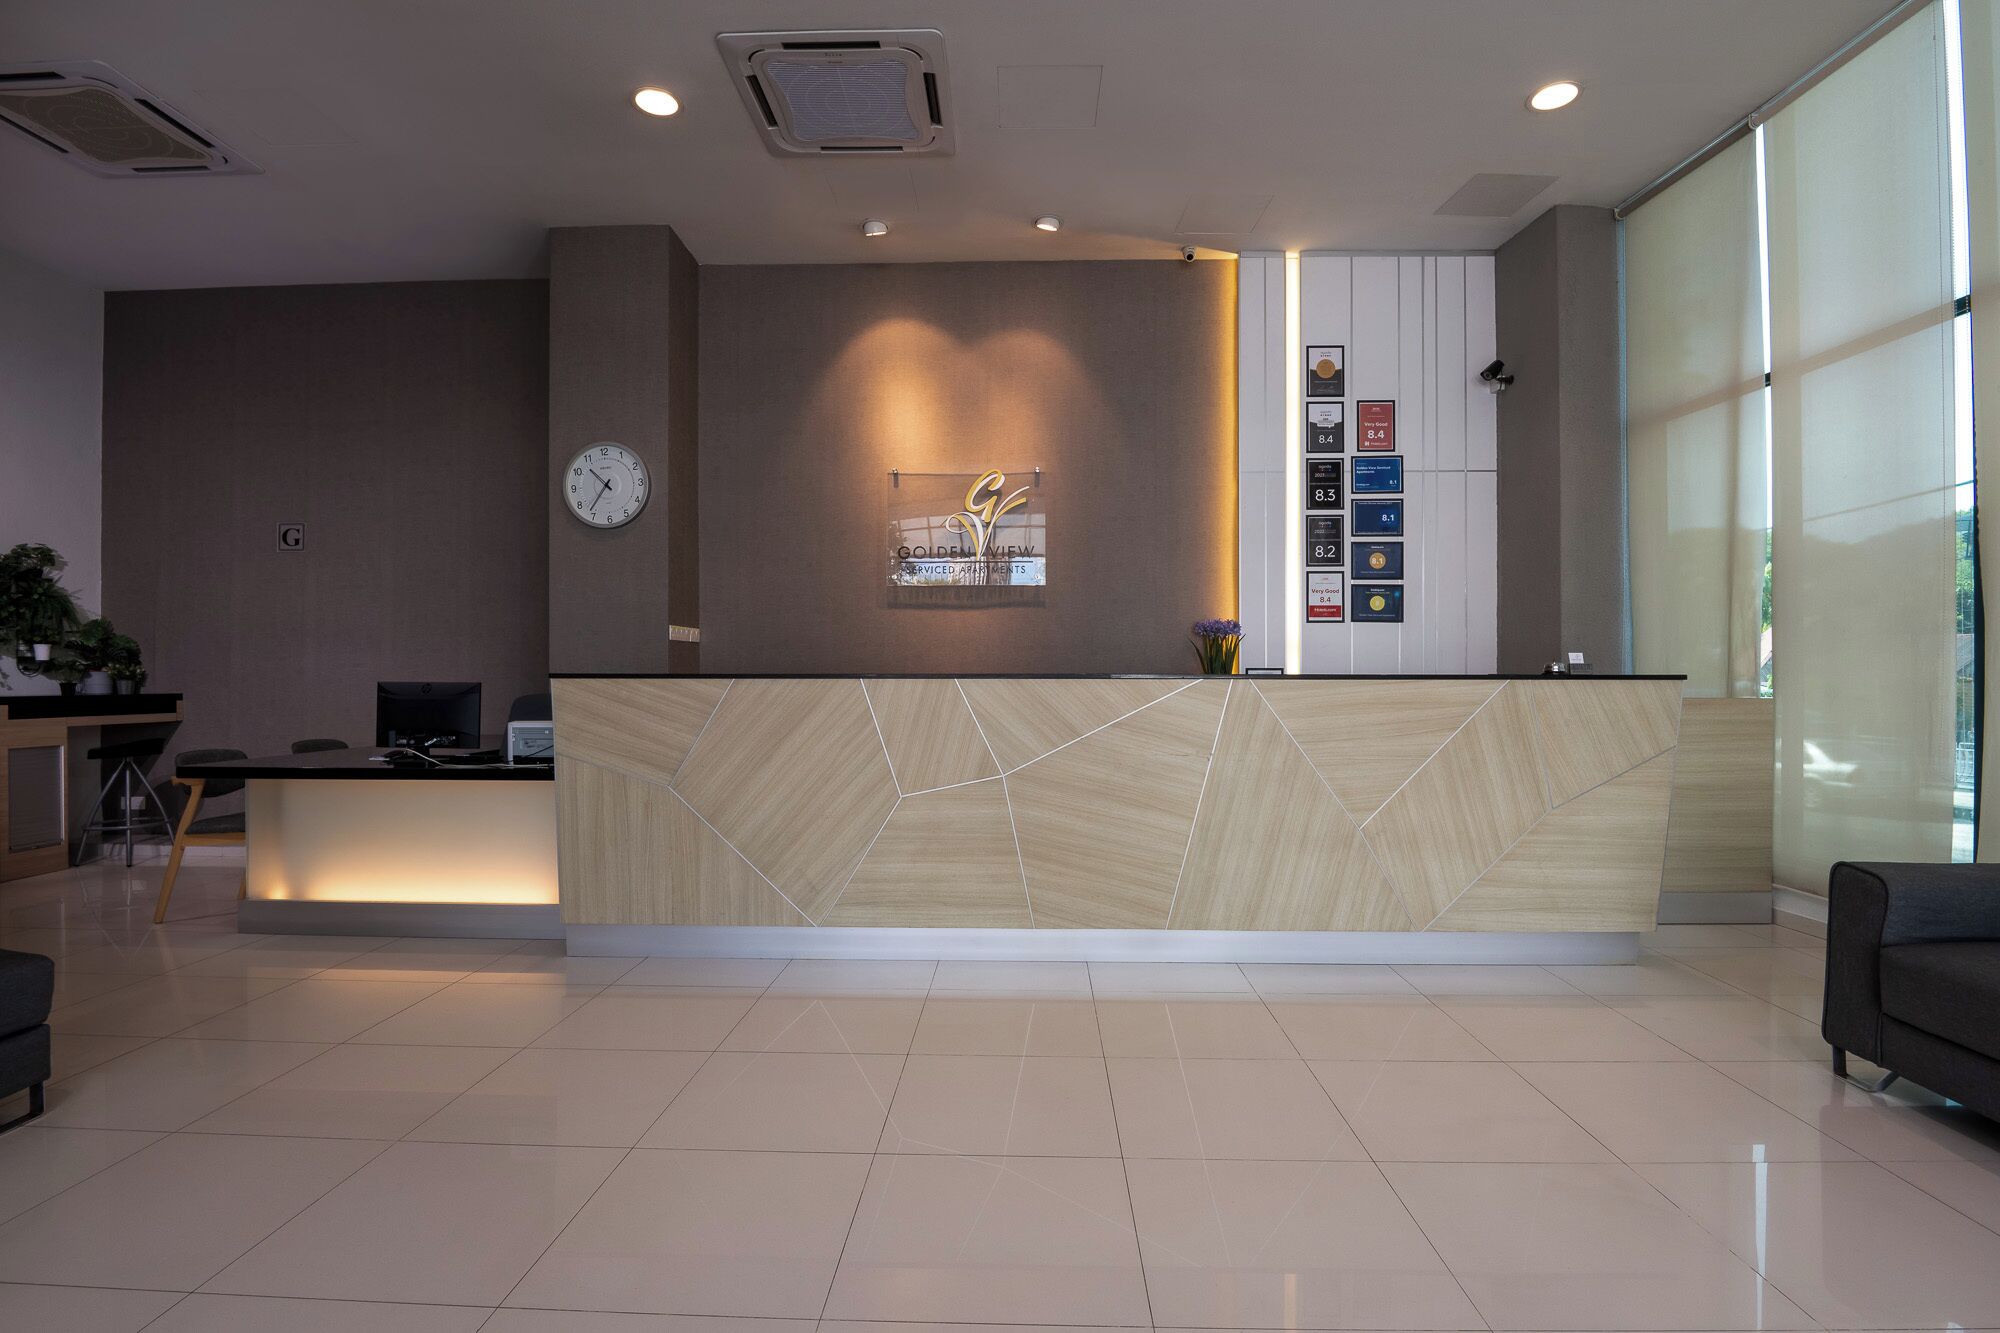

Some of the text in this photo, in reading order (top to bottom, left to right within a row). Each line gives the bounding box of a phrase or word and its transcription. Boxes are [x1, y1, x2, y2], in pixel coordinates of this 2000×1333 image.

[1368, 430, 1385, 439] 8.4
[1318, 435, 1334, 444] 8.4
[600, 447, 609, 456] 12
[584, 455, 592, 463] 11
[632, 462, 638, 471] 2
[573, 467, 582, 477] 10
[638, 478, 644, 487] 3
[571, 485, 577, 493] 9
[634, 495, 640, 504] 4
[1315, 489, 1336, 501] 8.3
[577, 501, 583, 510] 8
[591, 513, 596, 521] 7
[623, 509, 629, 518] 5
[607, 515, 613, 523] 6
[282, 528, 300, 546] G
[898, 546, 1035, 559] GOLDEN VIEW
[1315, 545, 1336, 558] 8.2
[906, 565, 1026, 574] SERVICED APARTMENTS
